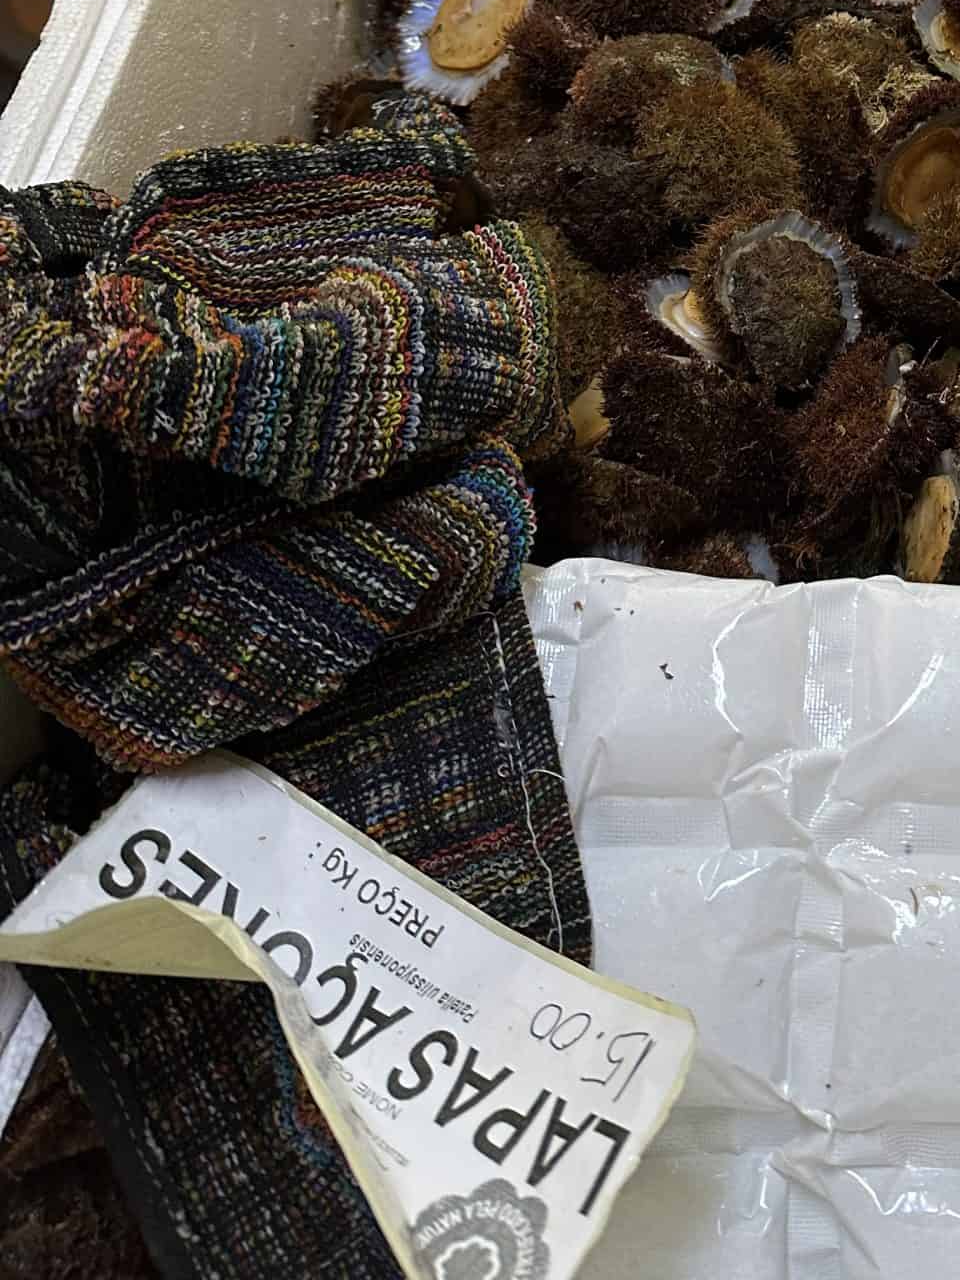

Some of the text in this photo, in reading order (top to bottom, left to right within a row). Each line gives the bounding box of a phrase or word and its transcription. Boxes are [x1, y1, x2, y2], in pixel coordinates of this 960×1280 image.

[357, 878, 446, 949] PREÇO
[436, 990, 480, 1024] Patella
[529, 1003, 657, 1102] 15.00
[351, 1081, 403, 1121] NOME
[386, 1029, 631, 1217] LAPAS
